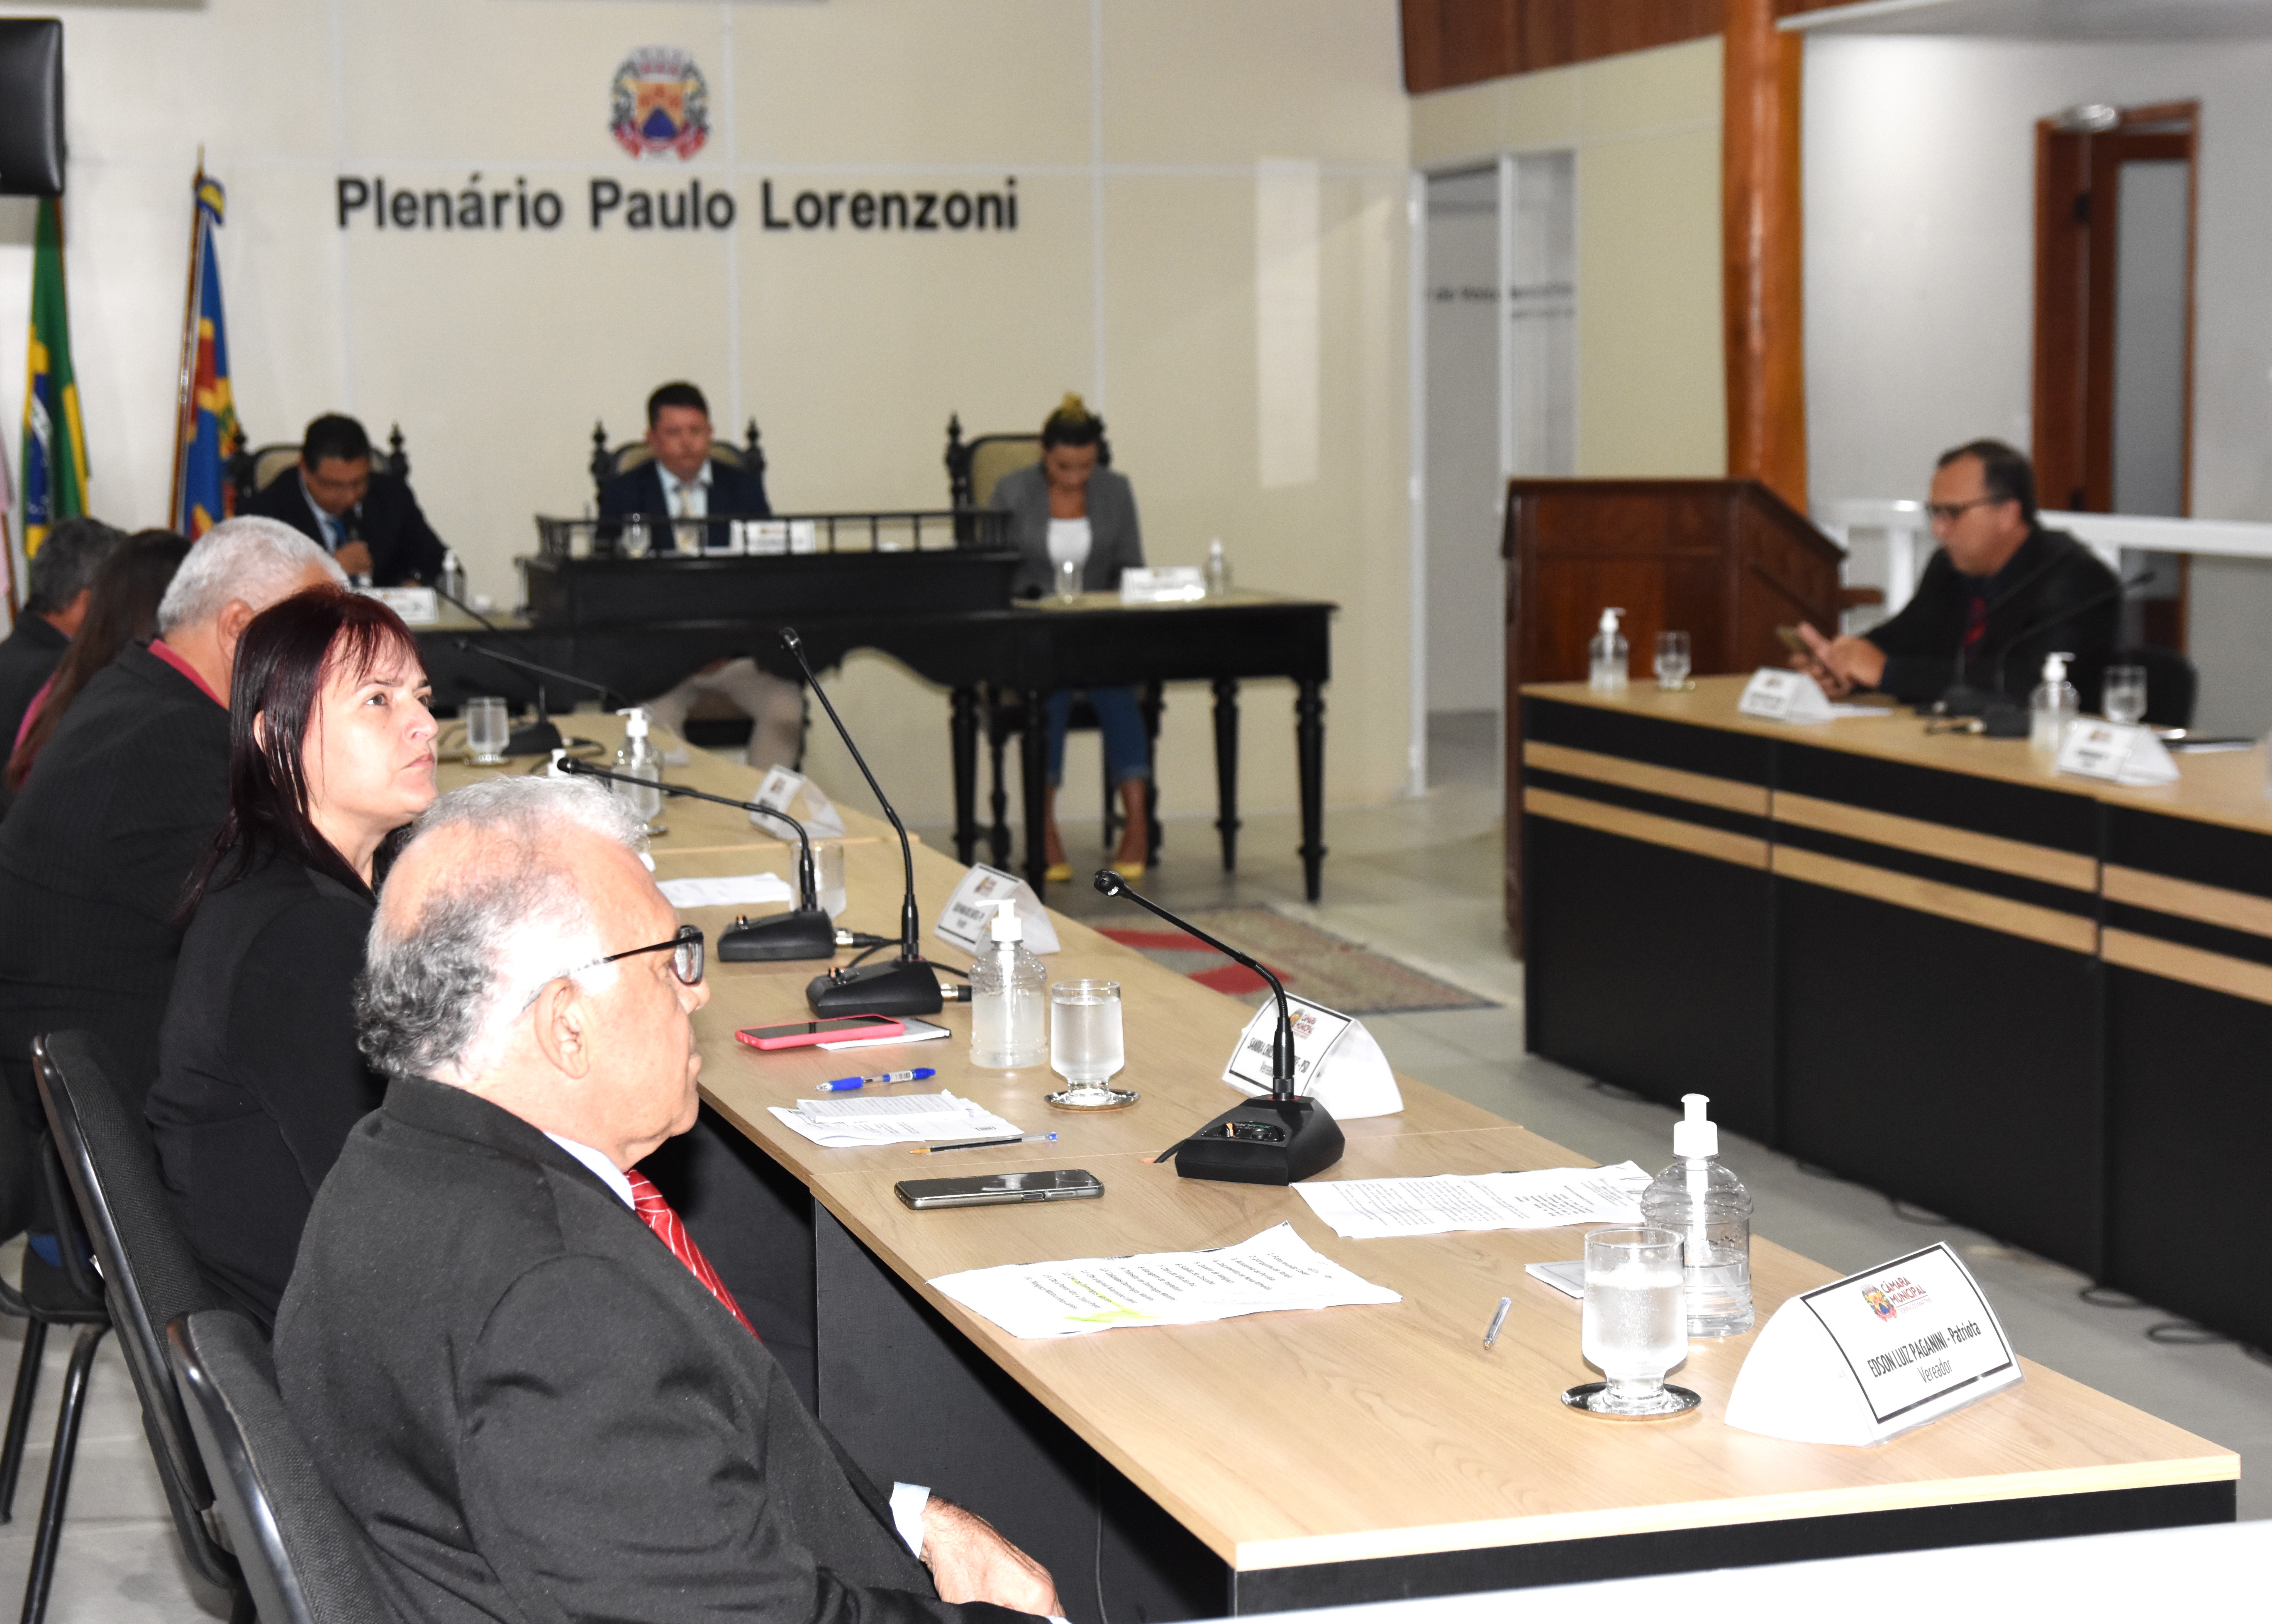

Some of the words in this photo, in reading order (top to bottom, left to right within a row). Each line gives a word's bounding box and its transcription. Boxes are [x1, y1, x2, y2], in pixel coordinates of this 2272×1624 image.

[335, 170, 563, 230] Plenário
[589, 176, 736, 230] Paulo
[761, 175, 1018, 230] Lorenzoni
[1142, 1268, 1160, 1279] Garagem
[1236, 1261, 1257, 1271] Academia
[1880, 1276, 1911, 1293] CÂMARA
[1889, 1284, 1926, 1305] MUNICIPAL
[1867, 1352, 1897, 1378] EDSON
[1891, 1345, 1914, 1368] LUIZ
[1909, 1331, 1948, 1361] PAGANINI
[1947, 1320, 1981, 1344] Patriota
[1917, 1358, 1952, 1383] Vereador
